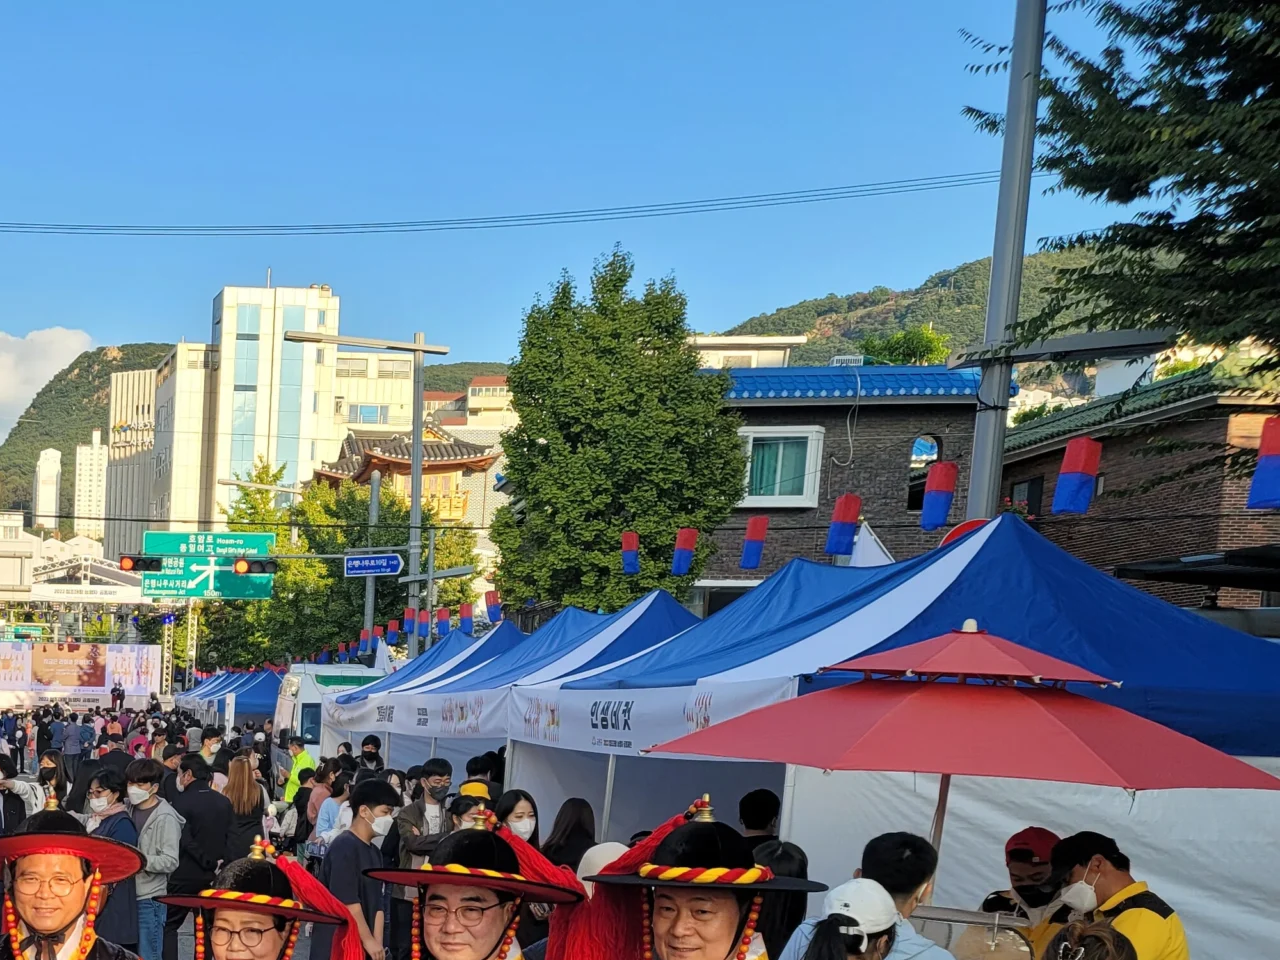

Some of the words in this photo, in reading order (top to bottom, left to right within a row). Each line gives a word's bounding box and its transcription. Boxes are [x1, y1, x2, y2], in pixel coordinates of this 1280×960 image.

[188, 534, 214, 543] 호암로
[216, 537, 244, 545] Hoam-ro
[144, 579, 187, 589] 은행나무사거리
[590, 700, 635, 731] 인생네컷
